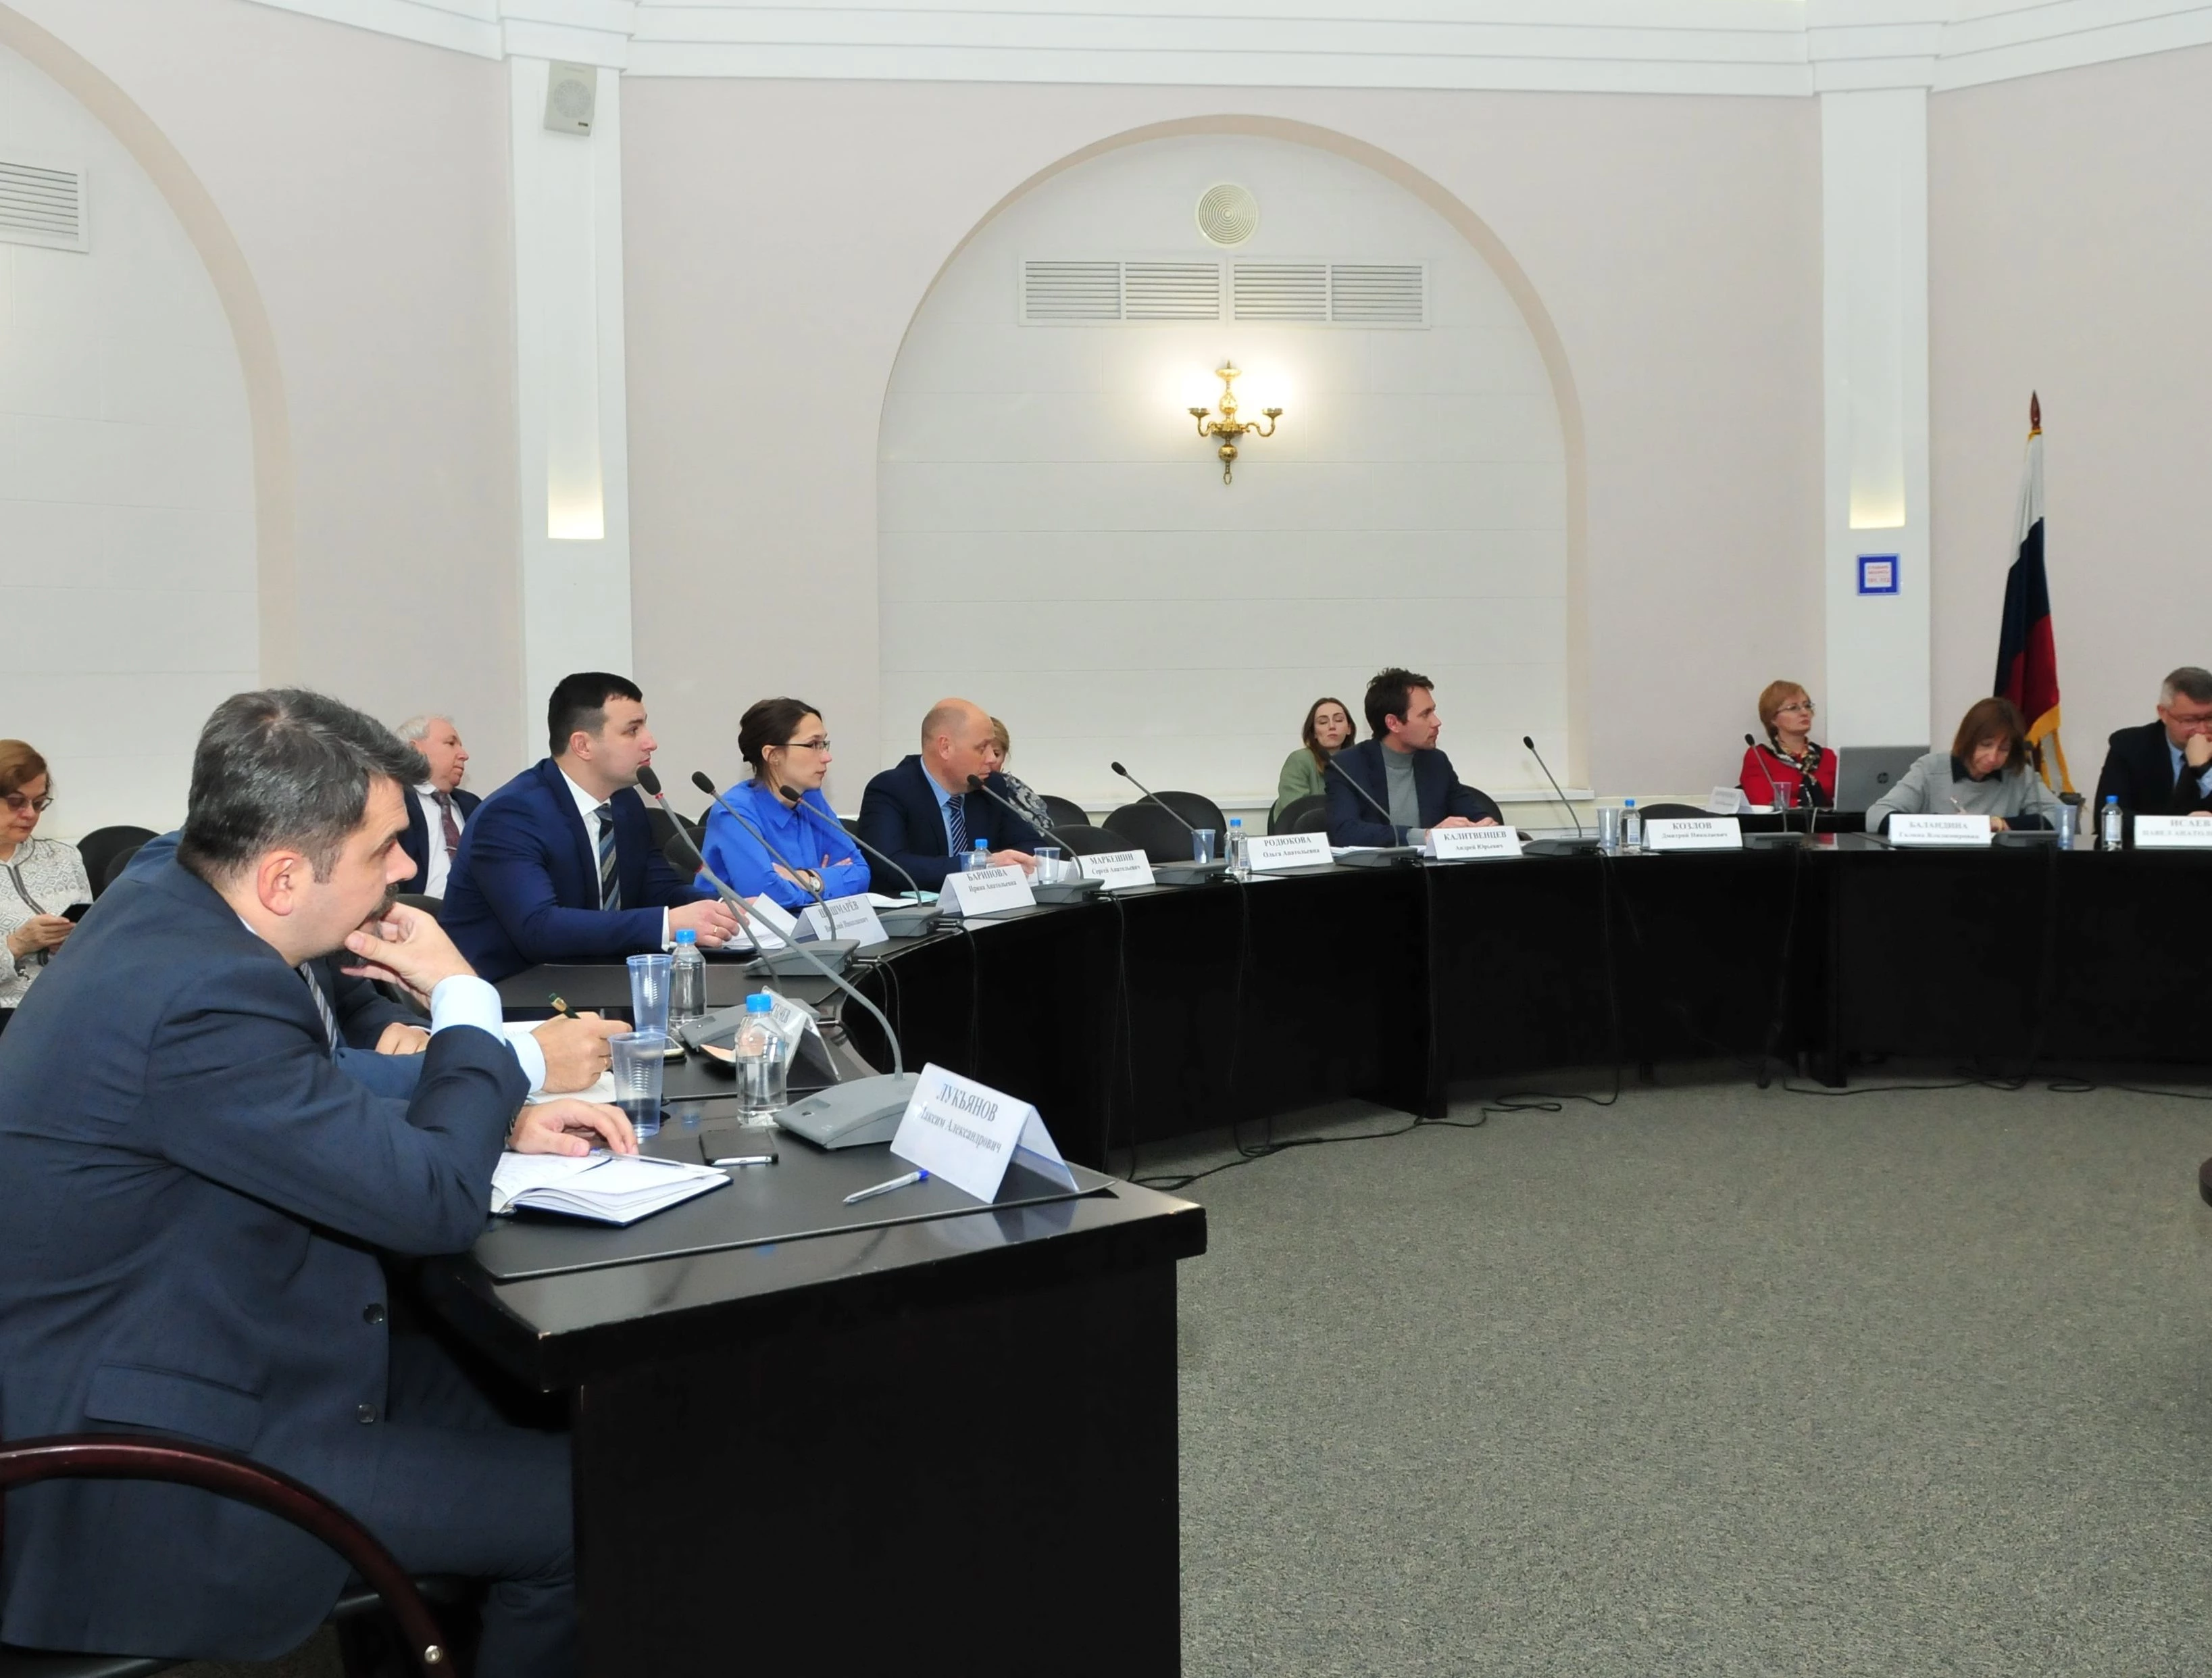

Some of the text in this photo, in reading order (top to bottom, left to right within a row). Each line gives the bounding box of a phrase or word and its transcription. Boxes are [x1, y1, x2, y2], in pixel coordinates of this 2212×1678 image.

[1672, 822, 1712, 830] КОЗЛОВ
[1909, 821, 1968, 830] БАЛАНДИНА
[2170, 819, 2211, 827] ИСАЕВ
[1443, 831, 1507, 841] КАЛИТВЕНЦЕВ
[1263, 836, 1311, 847] РОДЮКОВА
[1089, 853, 1134, 864] МАРКЕШИН
[966, 868, 1008, 881] БАРИНОВА
[968, 885, 986, 893] Ирина
[946, 1118, 1003, 1154] Александрович
